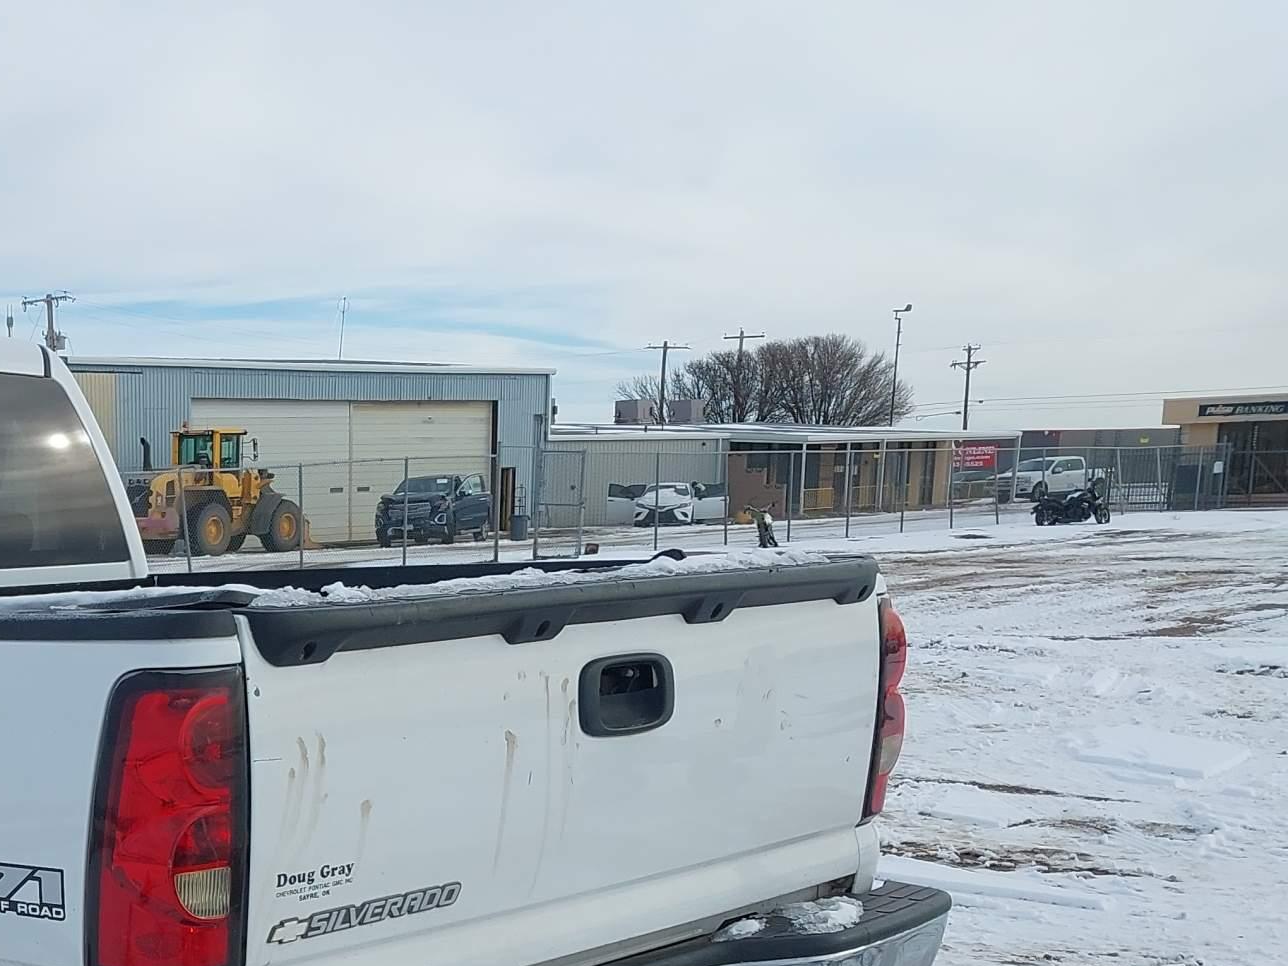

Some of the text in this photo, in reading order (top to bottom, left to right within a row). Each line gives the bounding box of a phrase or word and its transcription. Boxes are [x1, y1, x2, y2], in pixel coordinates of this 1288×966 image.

[276, 862, 355, 888] Doug Gray
[276, 887, 307, 898] CHEVROLET
[308, 882, 330, 892] PONTIAC
[17, 903, 65, 919] ROAD
[307, 881, 462, 937] SILVERADO
